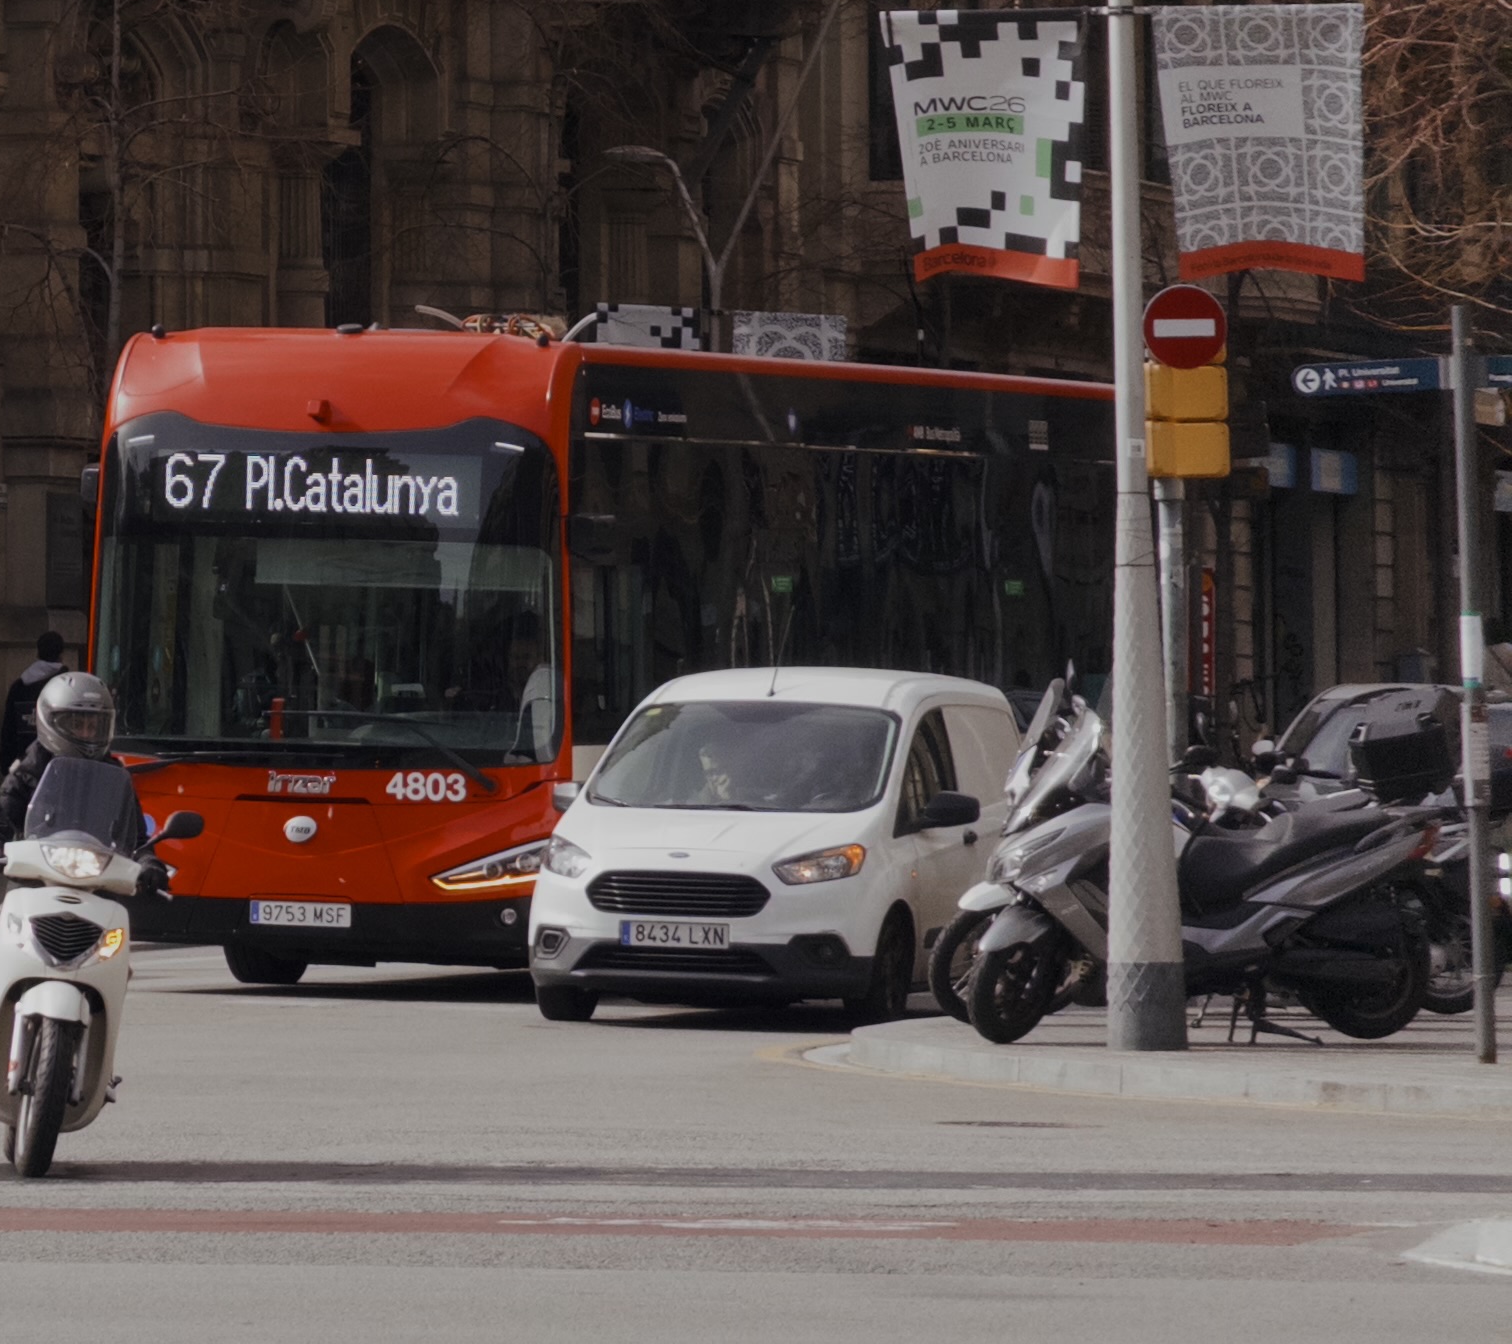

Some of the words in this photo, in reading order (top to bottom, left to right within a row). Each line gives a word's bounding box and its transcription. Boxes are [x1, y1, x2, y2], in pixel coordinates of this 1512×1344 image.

[1178, 81, 1192, 92] EL
[1197, 79, 1225, 90] QUE
[1229, 78, 1283, 89] FLOREIX
[913, 95, 1026, 116] MWC26
[1180, 93, 1196, 104] AL
[1199, 91, 1233, 101] MWC
[1181, 102, 1238, 116] FLOREIX
[1243, 102, 1253, 112] A
[926, 117, 957, 131] 2-5
[965, 116, 1015, 134] MARÇ
[1182, 114, 1265, 129] BARCELONA
[920, 156, 929, 167] A
[932, 151, 1013, 165] BARCELONA
[923, 252, 987, 271] Barcelona
[164, 452, 227, 509] 67
[245, 454, 459, 517] Pl.Catalunya
[385, 771, 467, 802] 4803
[262, 904, 307, 922] 9753
[313, 906, 346, 924] MSF
[635, 924, 681, 943] 8434
[689, 926, 724, 945] LXN
